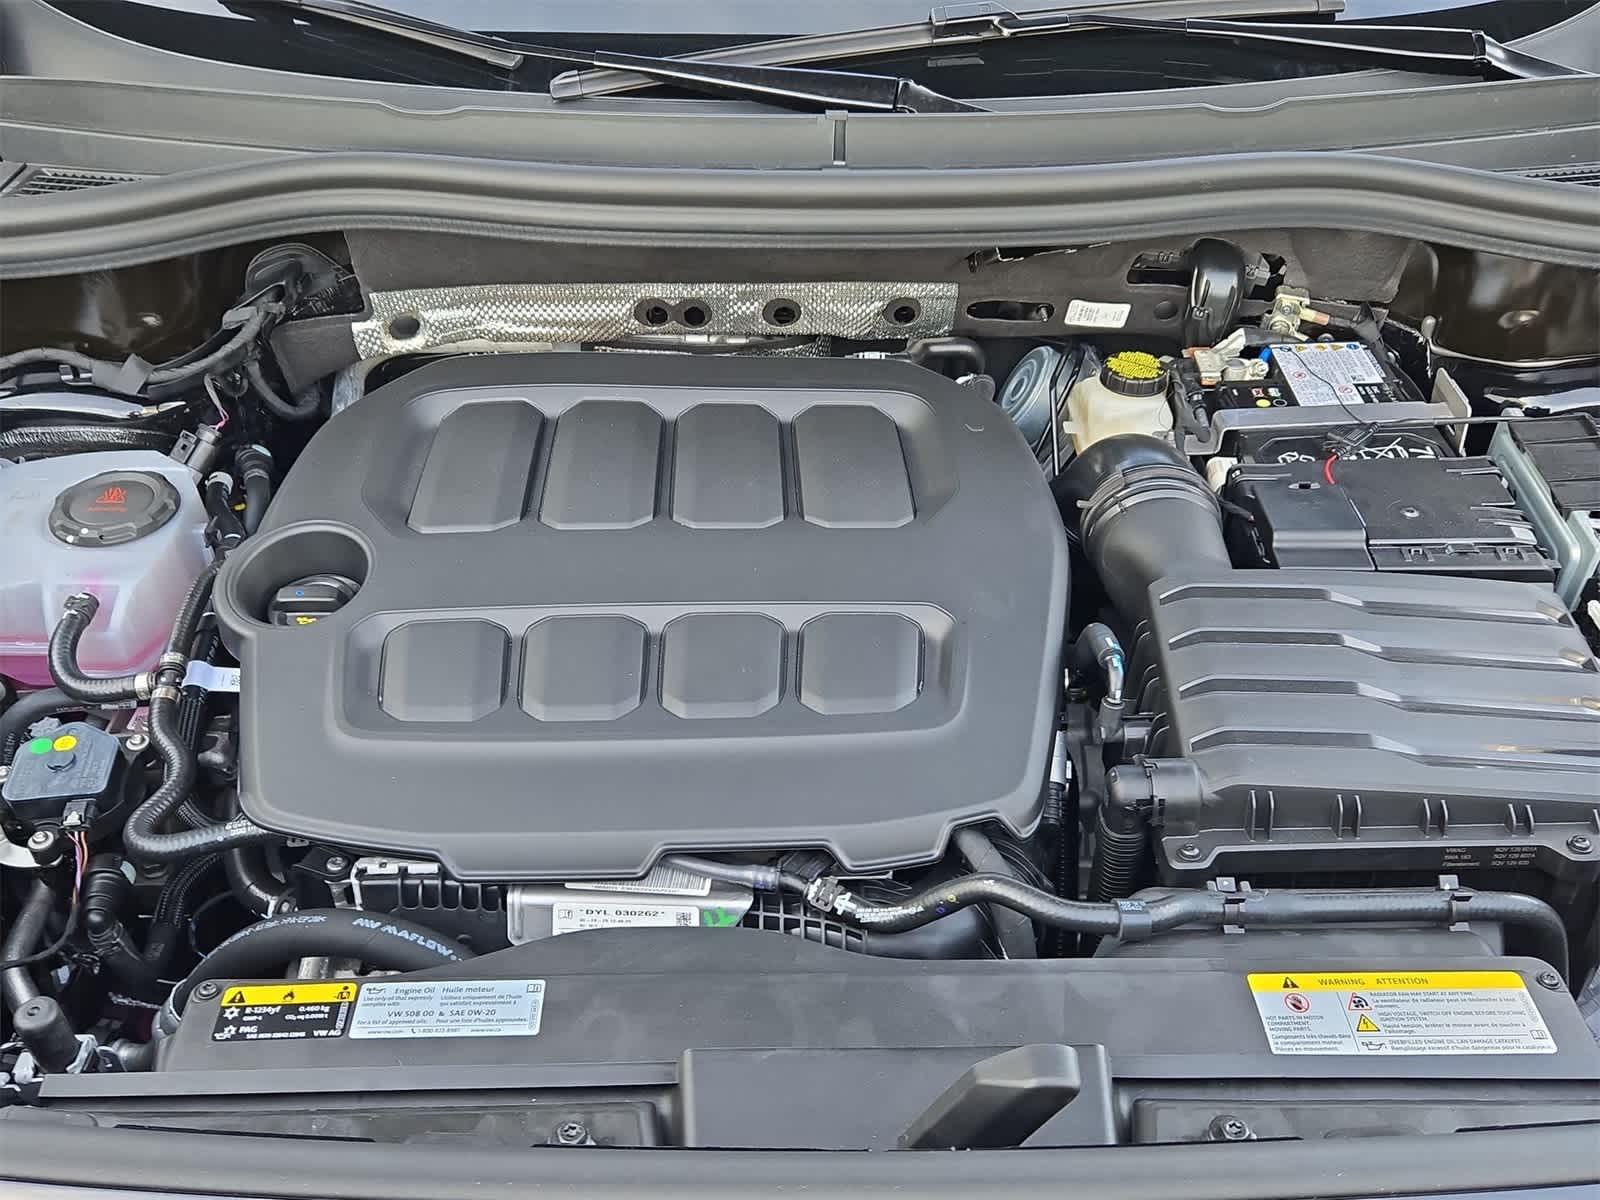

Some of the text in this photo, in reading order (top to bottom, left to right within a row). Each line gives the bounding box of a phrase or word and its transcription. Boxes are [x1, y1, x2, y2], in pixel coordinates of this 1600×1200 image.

[1318, 977, 1429, 986] WARNING ATTENTION
[395, 986, 435, 996] Engine Oil
[442, 985, 495, 993] Huile moteur
[245, 1006, 282, 1015] R-1234yf
[449, 1009, 465, 1017] SAE
[467, 1008, 496, 1016] 0W-20
[239, 1025, 258, 1033] PAG
[328, 1029, 342, 1037] AG
